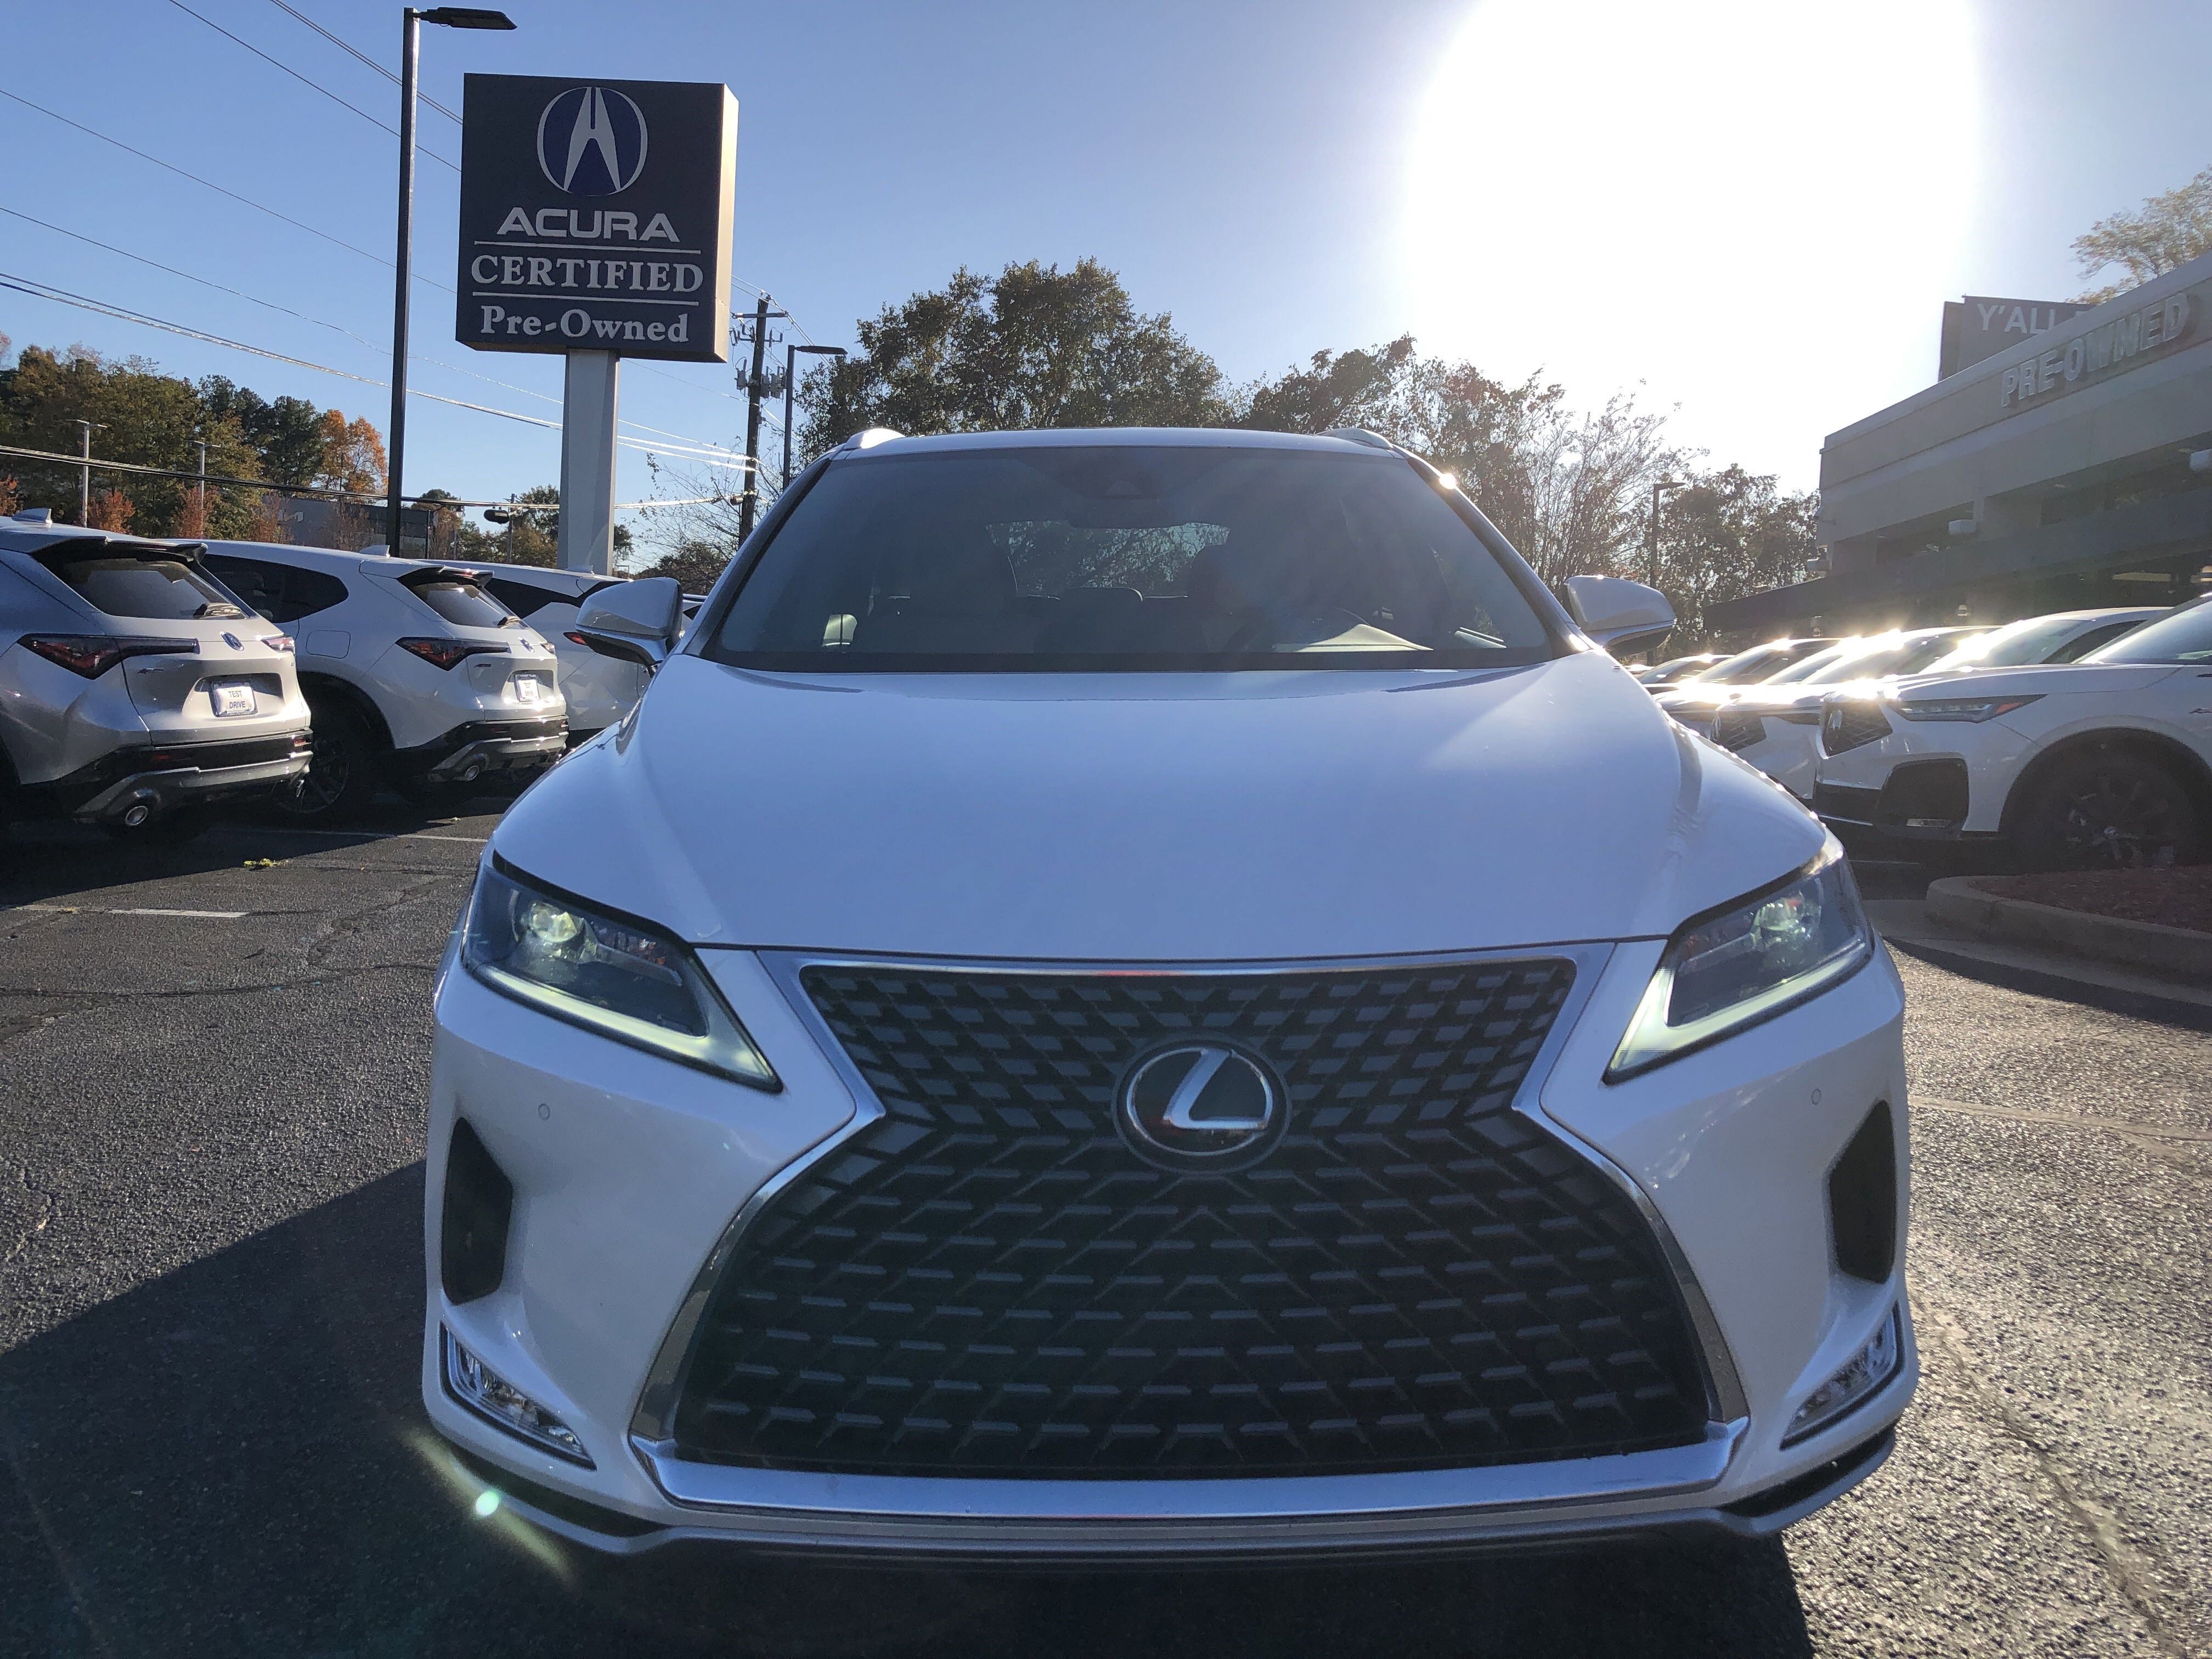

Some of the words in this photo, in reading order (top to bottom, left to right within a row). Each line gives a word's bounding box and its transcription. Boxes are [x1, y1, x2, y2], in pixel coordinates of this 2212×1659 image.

[496, 207, 680, 242] ACURA
[471, 255, 704, 292] CERTIFIED
[481, 305, 689, 343] Pre-Owned
[2001, 292, 2191, 407] PRE-OWNED
